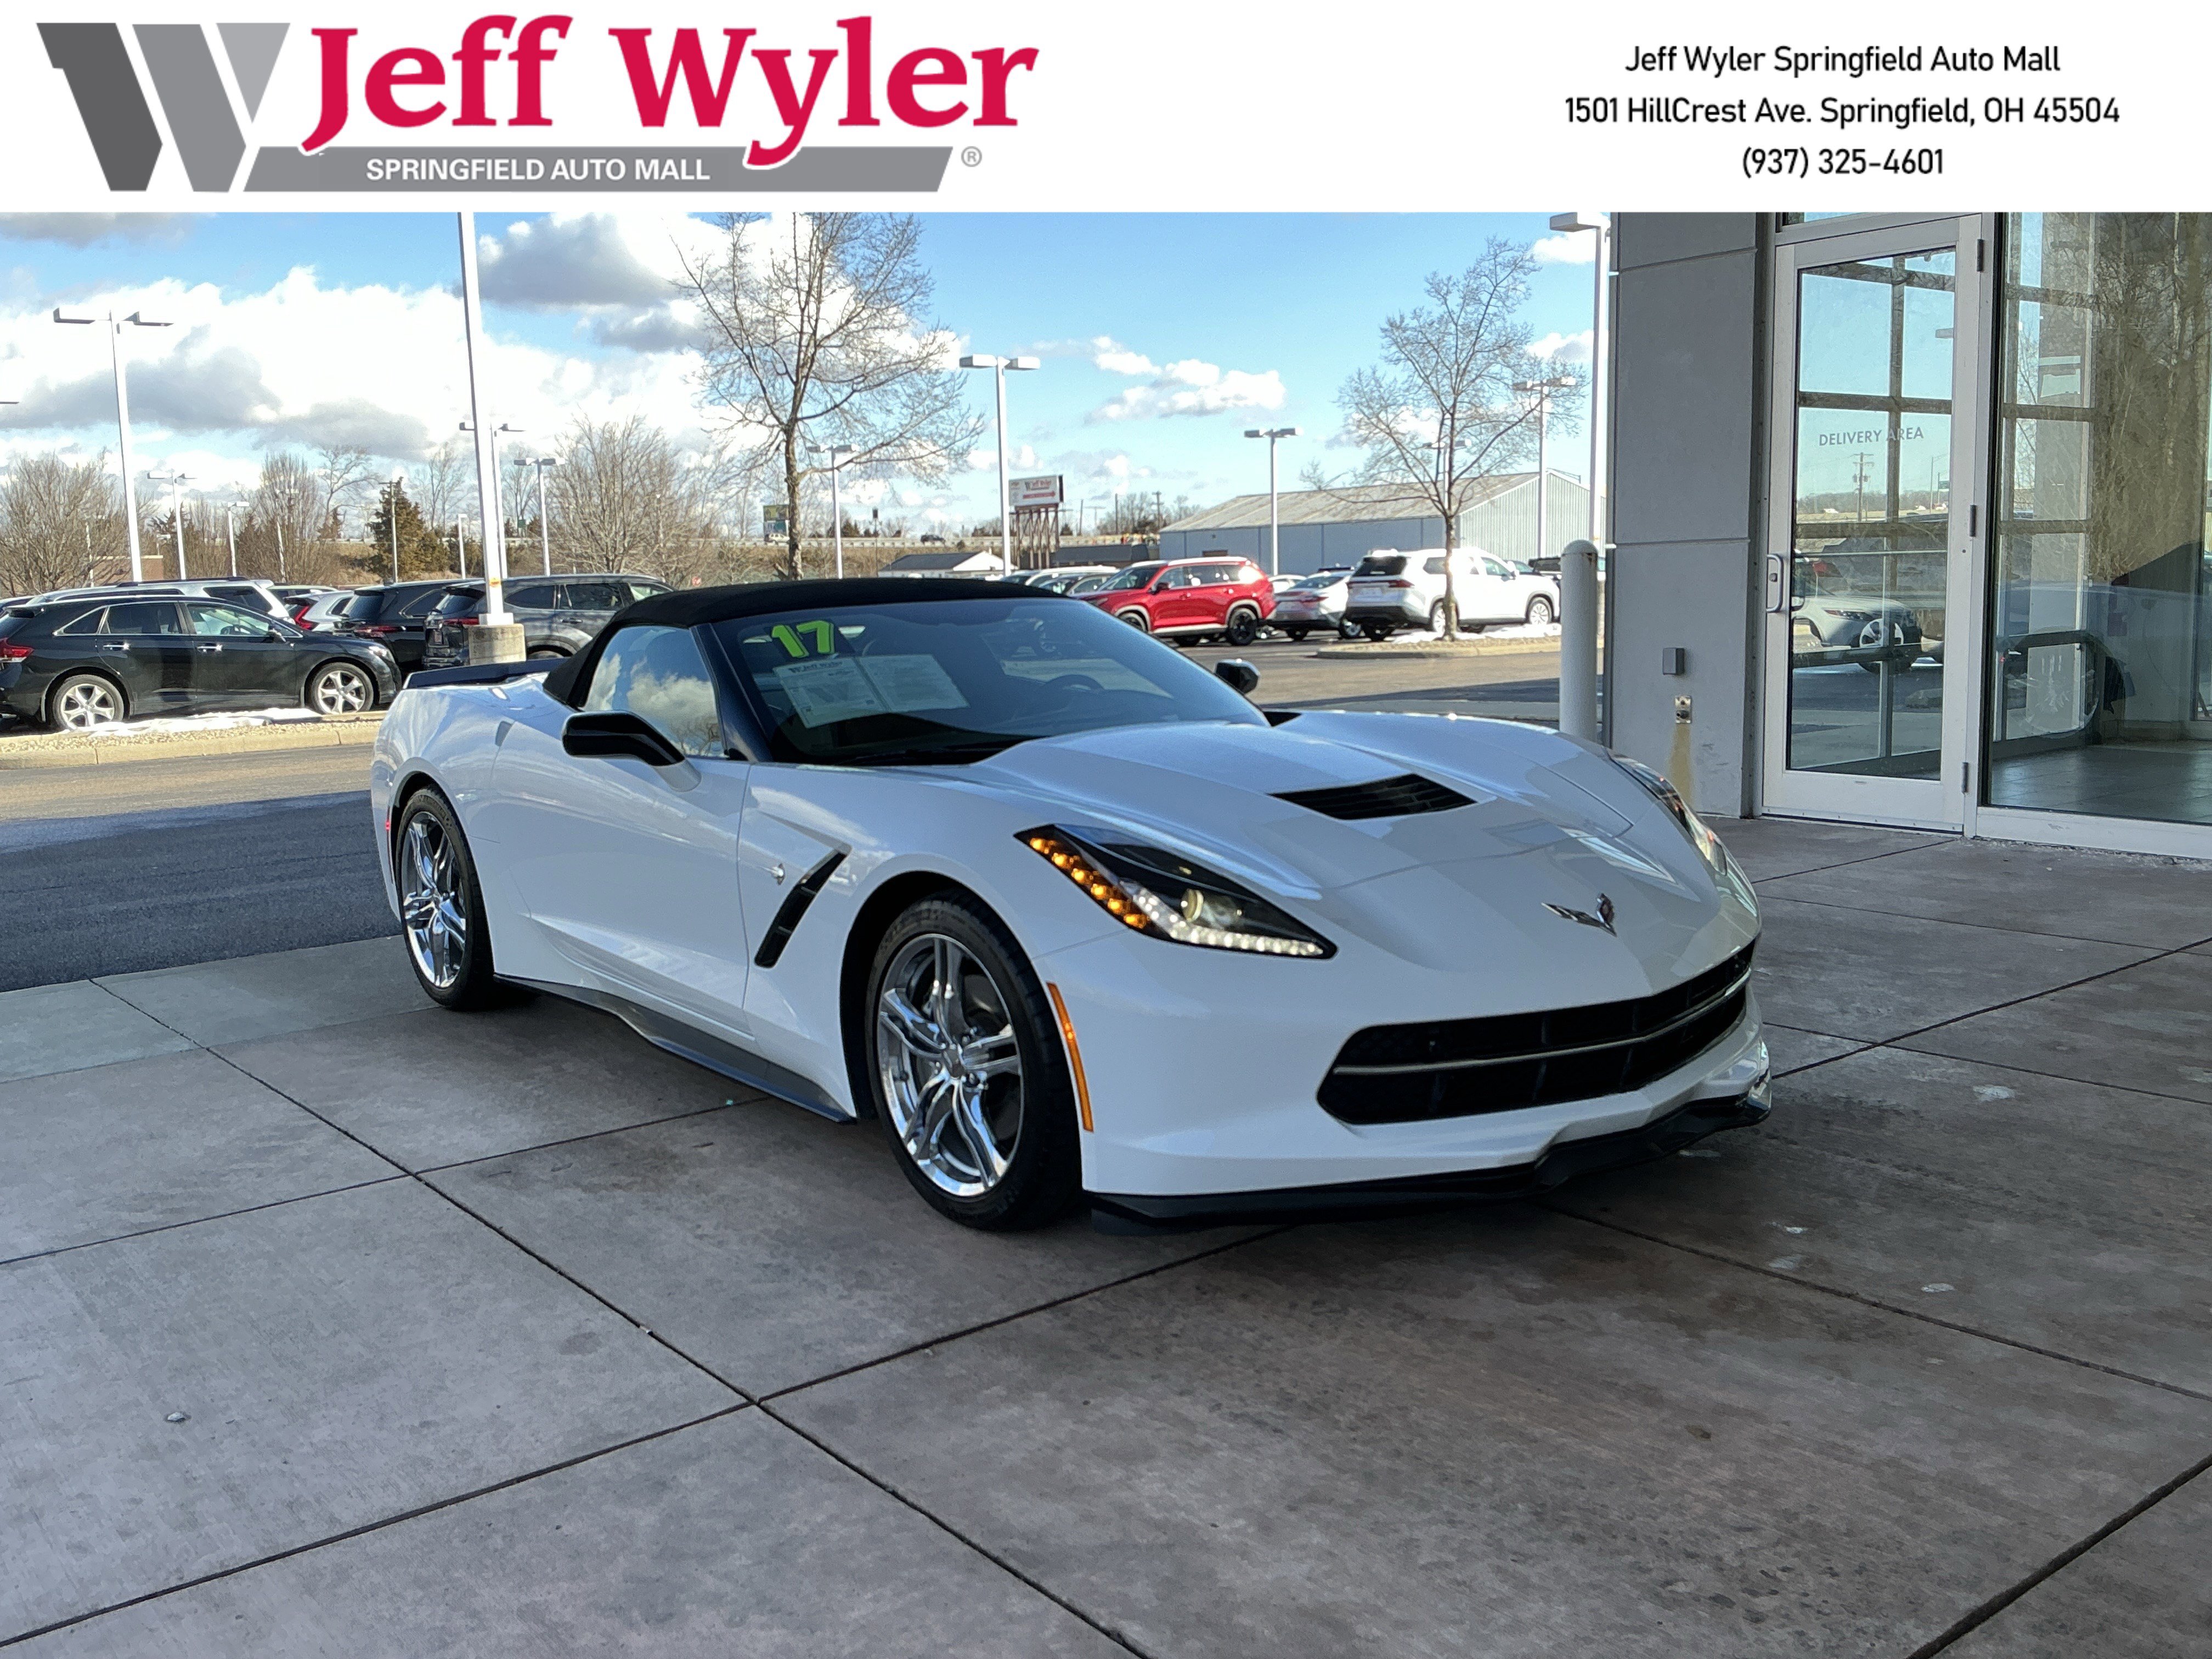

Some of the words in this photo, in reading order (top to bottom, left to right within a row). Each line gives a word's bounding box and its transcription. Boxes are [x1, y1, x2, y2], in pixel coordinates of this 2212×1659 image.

[1819, 430, 1882, 446] DELIVERY
[1886, 426, 1925, 442] AREA
[771, 620, 835, 658] 17
